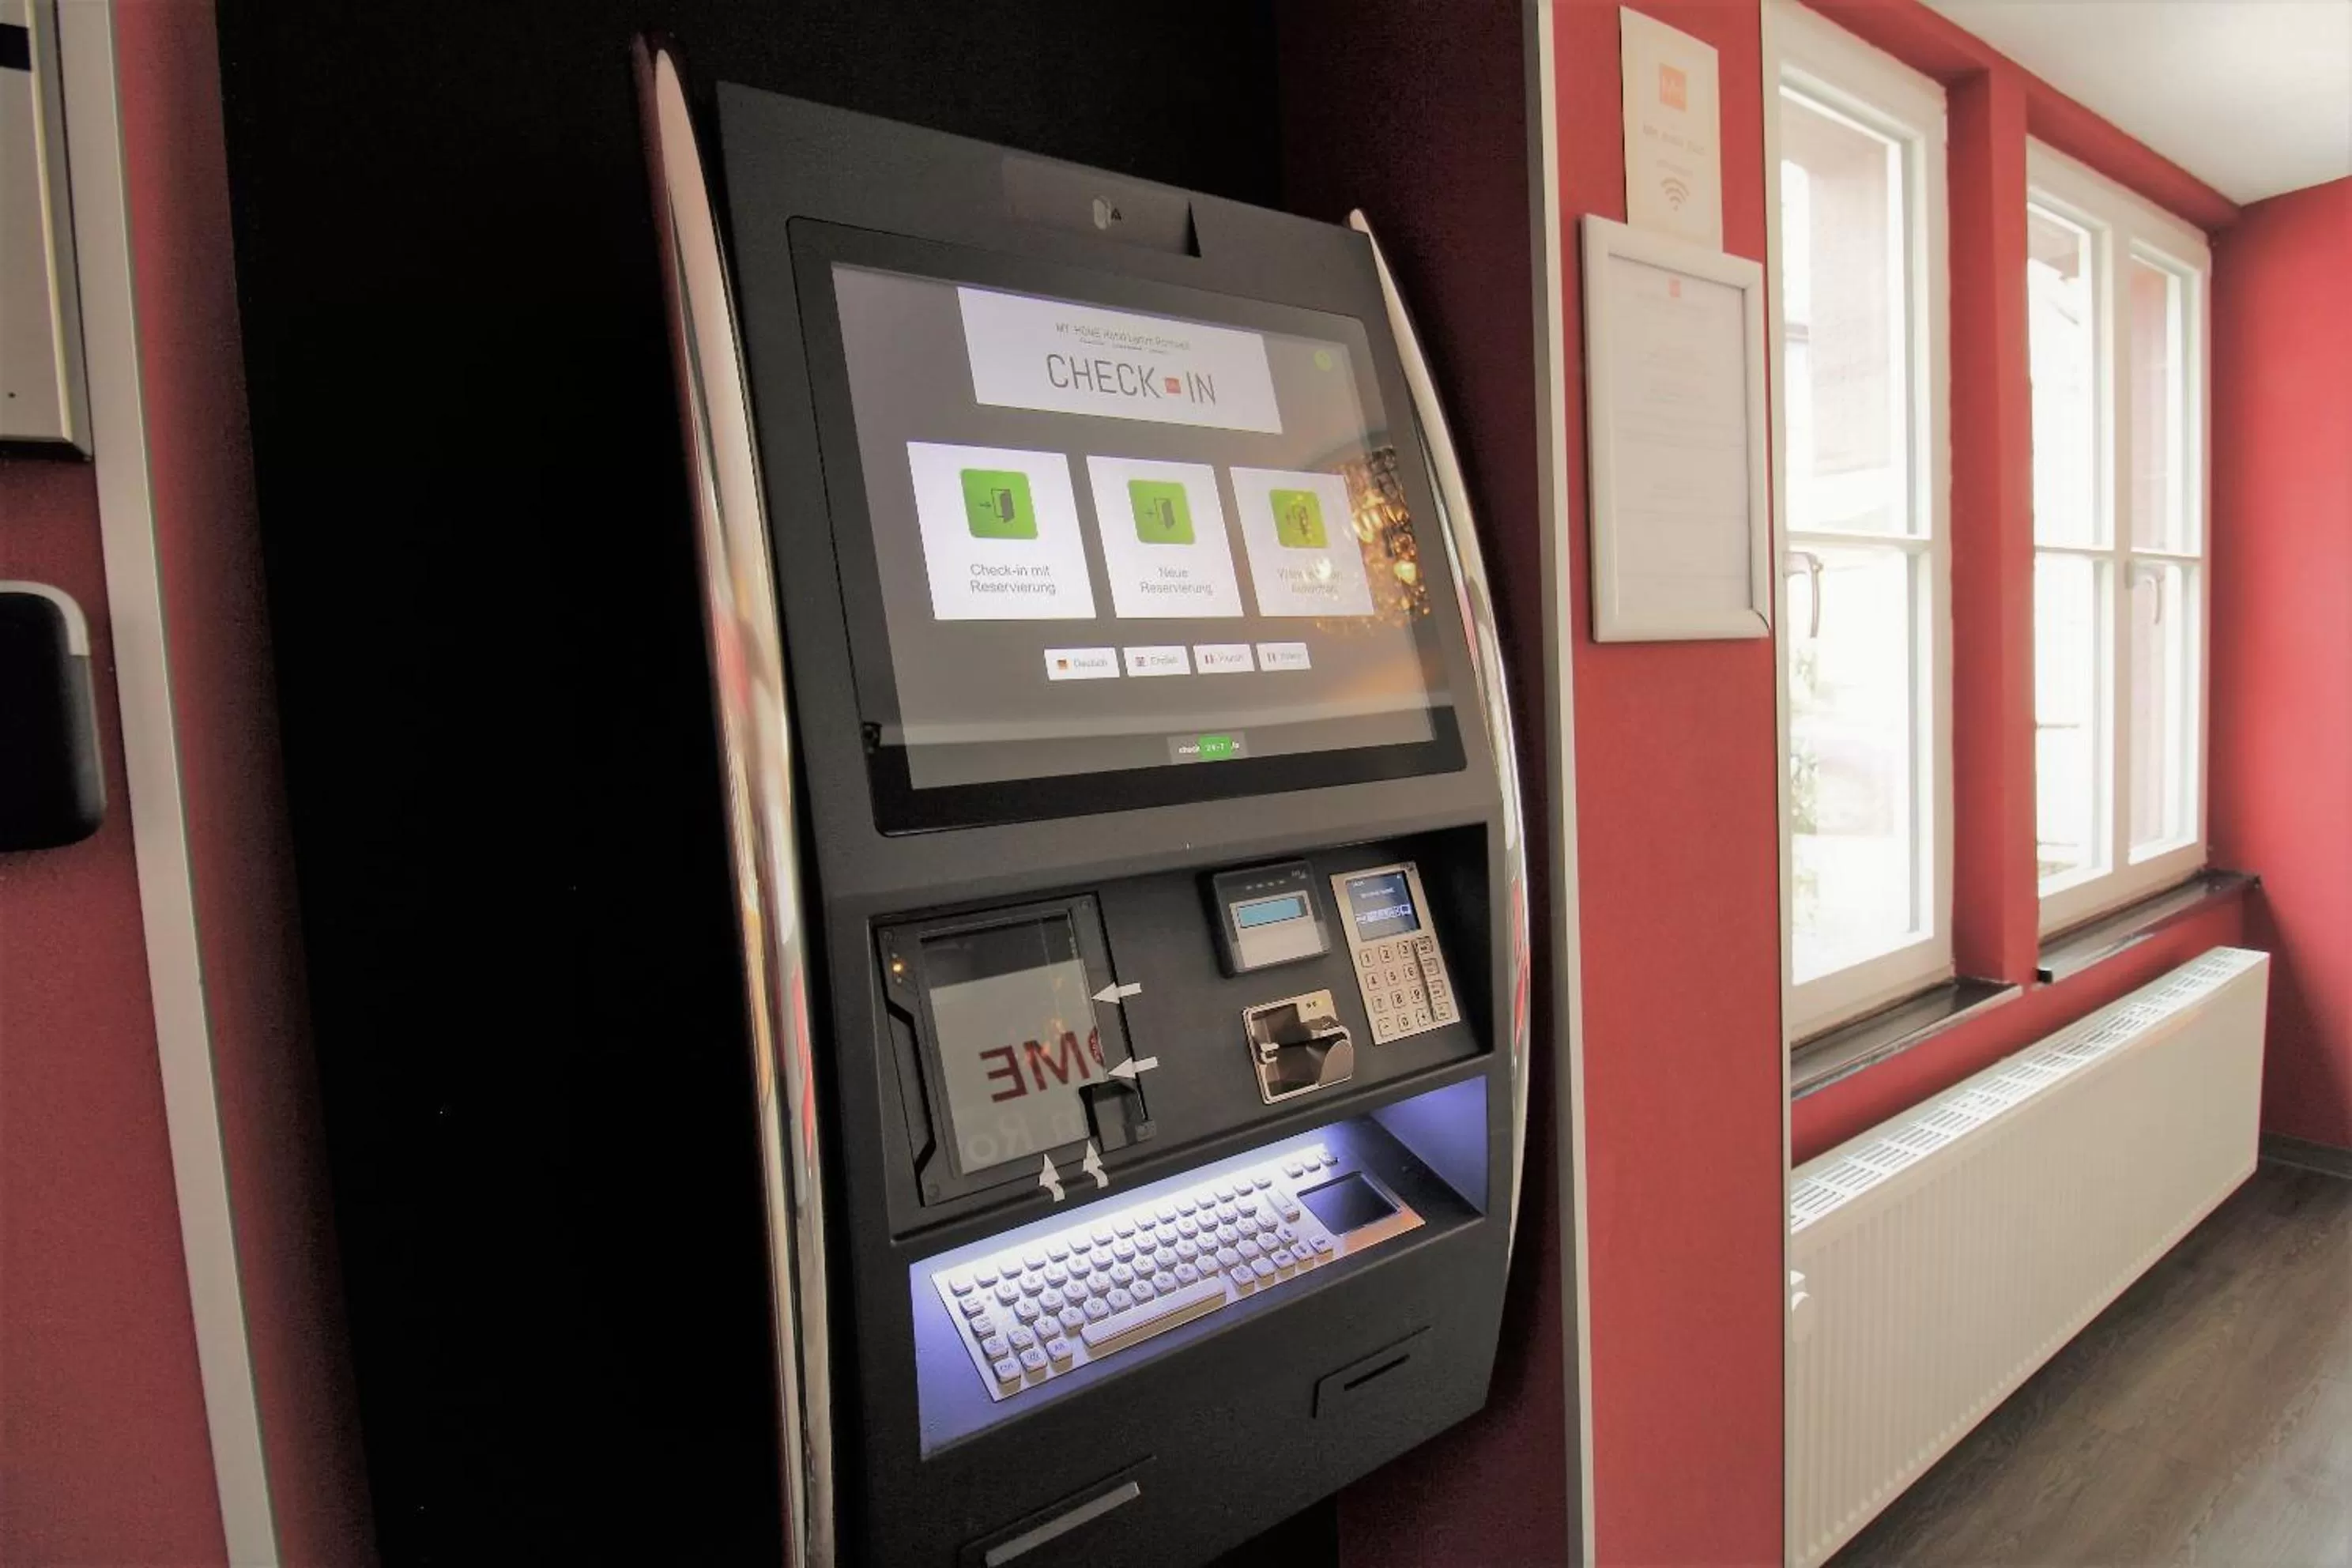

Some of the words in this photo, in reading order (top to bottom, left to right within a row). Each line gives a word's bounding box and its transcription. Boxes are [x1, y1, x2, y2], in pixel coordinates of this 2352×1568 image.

[1046, 353, 1163, 399] CHECK
[1185, 371, 1216, 405] IN
[970, 563, 1028, 576] Check-in
[1031, 564, 1050, 576] mit
[1157, 567, 1189, 579] Neue
[970, 579, 1056, 595] Reservierung
[1140, 581, 1214, 596] Reservierung
